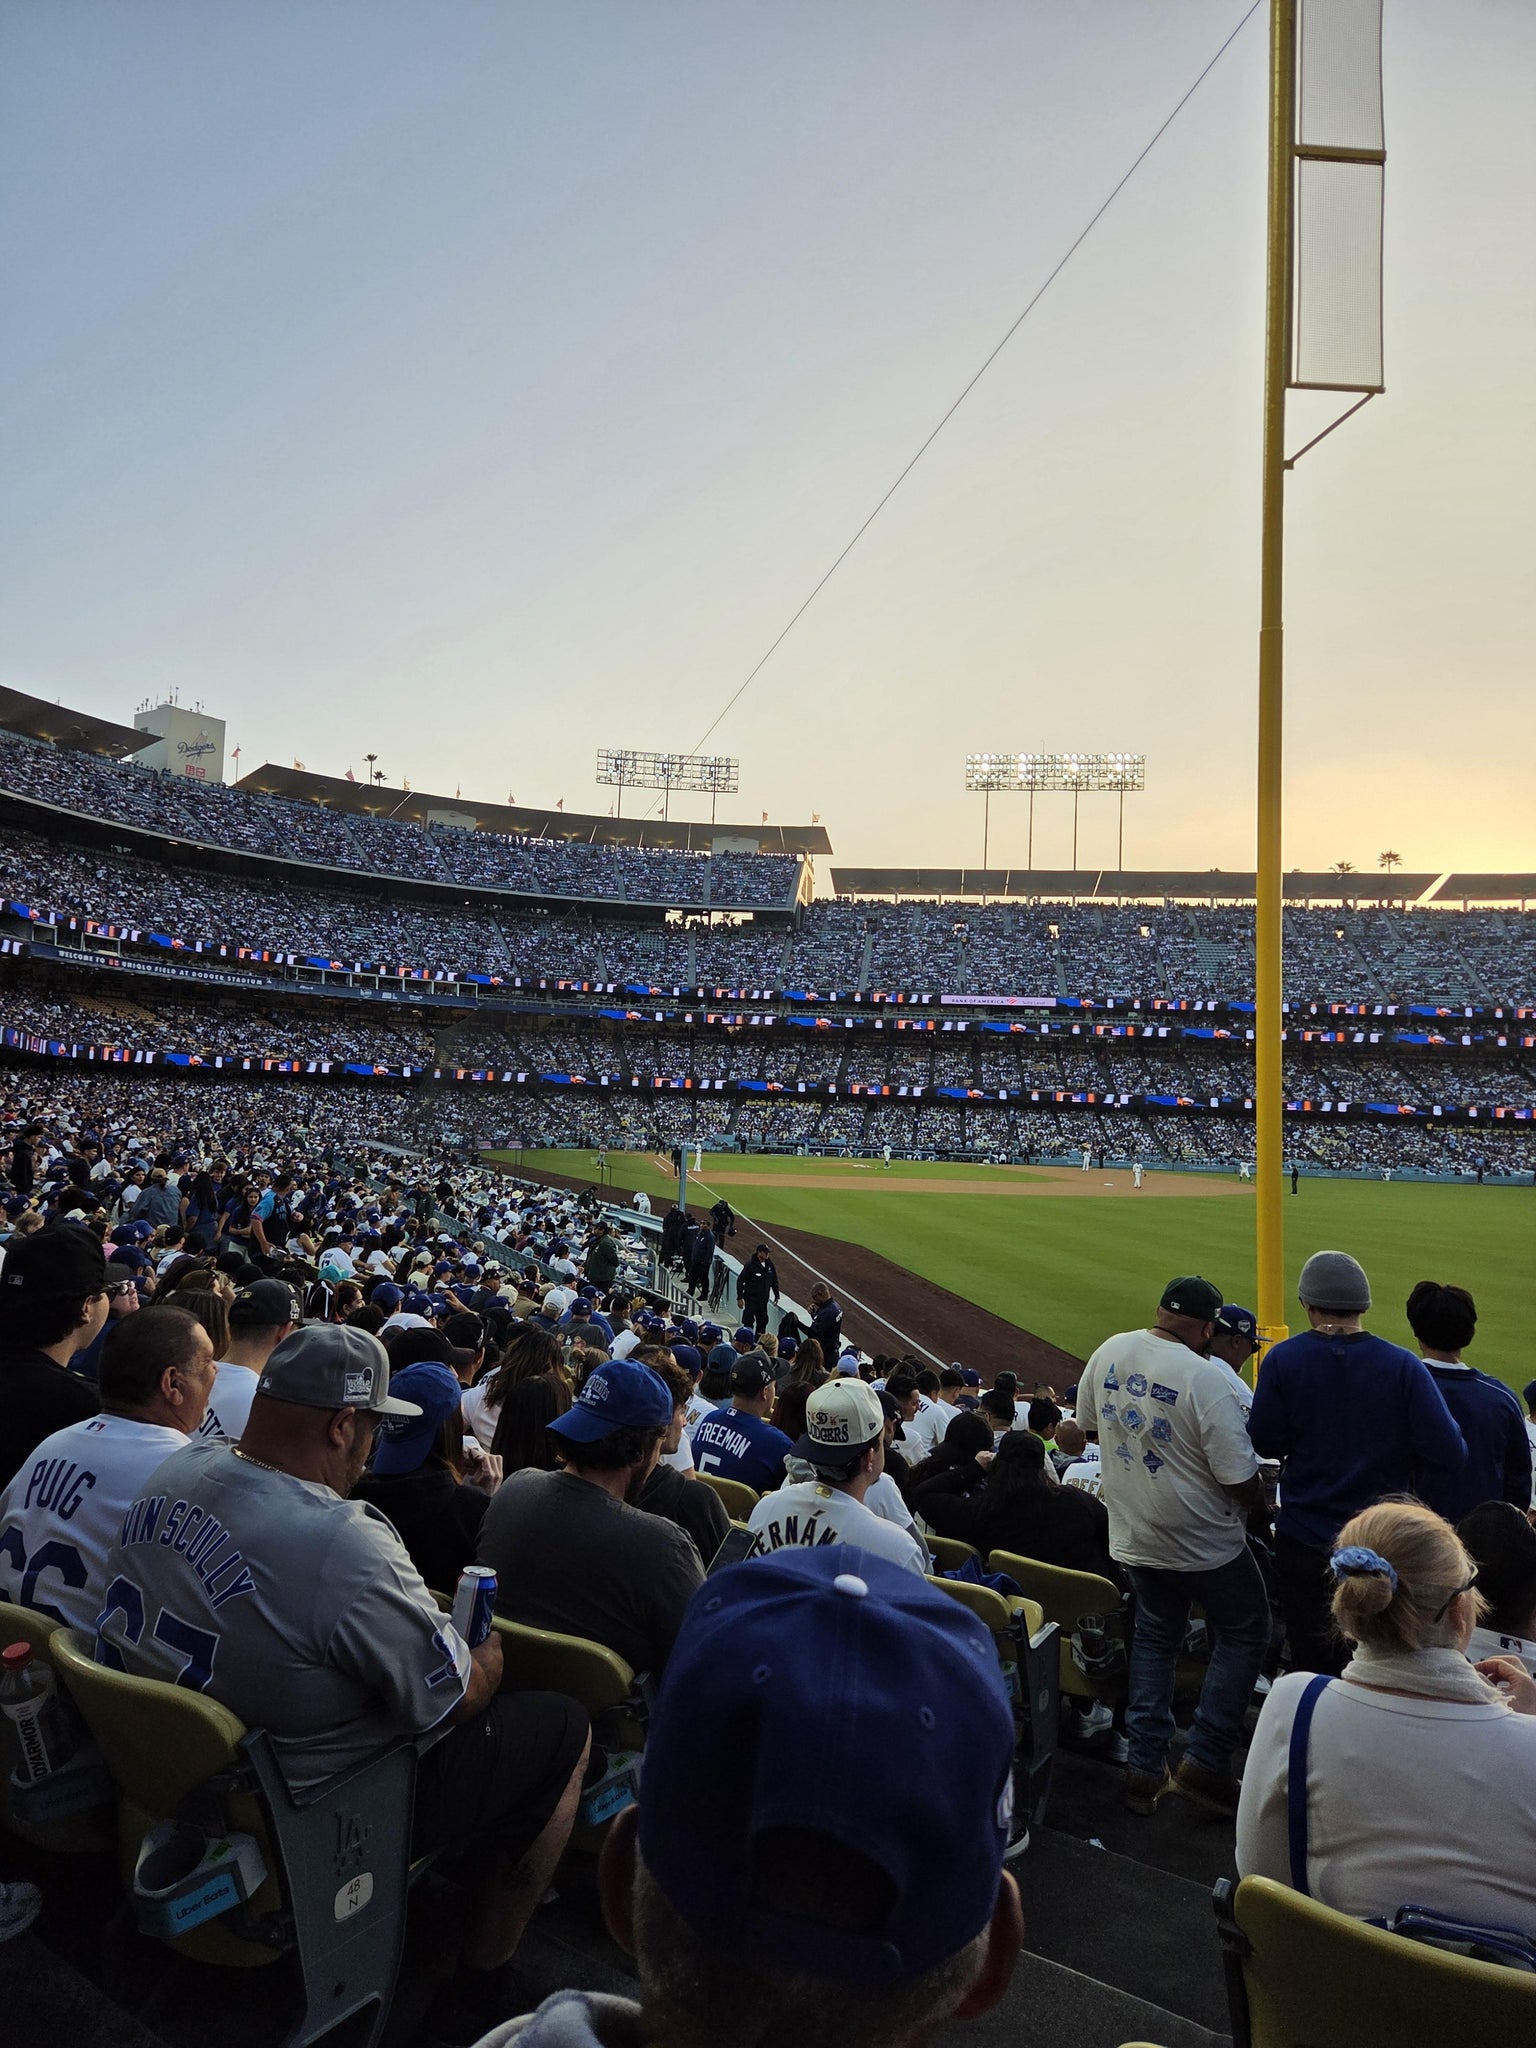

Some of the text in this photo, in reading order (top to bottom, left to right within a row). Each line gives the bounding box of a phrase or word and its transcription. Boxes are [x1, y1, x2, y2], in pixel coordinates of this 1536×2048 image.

[177, 741, 216, 757] Dodgers
[58, 950, 93, 962] WELCOME
[121, 961, 152, 971] UNIQLO
[154, 966, 176, 974] FIELD
[191, 971, 224, 981] DODGER
[227, 976, 263, 985] STADIUM
[347, 1379, 371, 1387] WORLD
[696, 1422, 752, 1459] FREEMAN
[809, 1422, 849, 1443] DGERS
[24, 1458, 97, 1521] PUIG
[752, 1509, 838, 1558] ERNÁN
[120, 1496, 257, 1609] VIN SCULLY
[20, 1714, 49, 1779] DYARMOR
[175, 1885, 230, 1920] Uber Eats
[347, 1878, 361, 1895] 48
[349, 1895, 359, 1910] N
